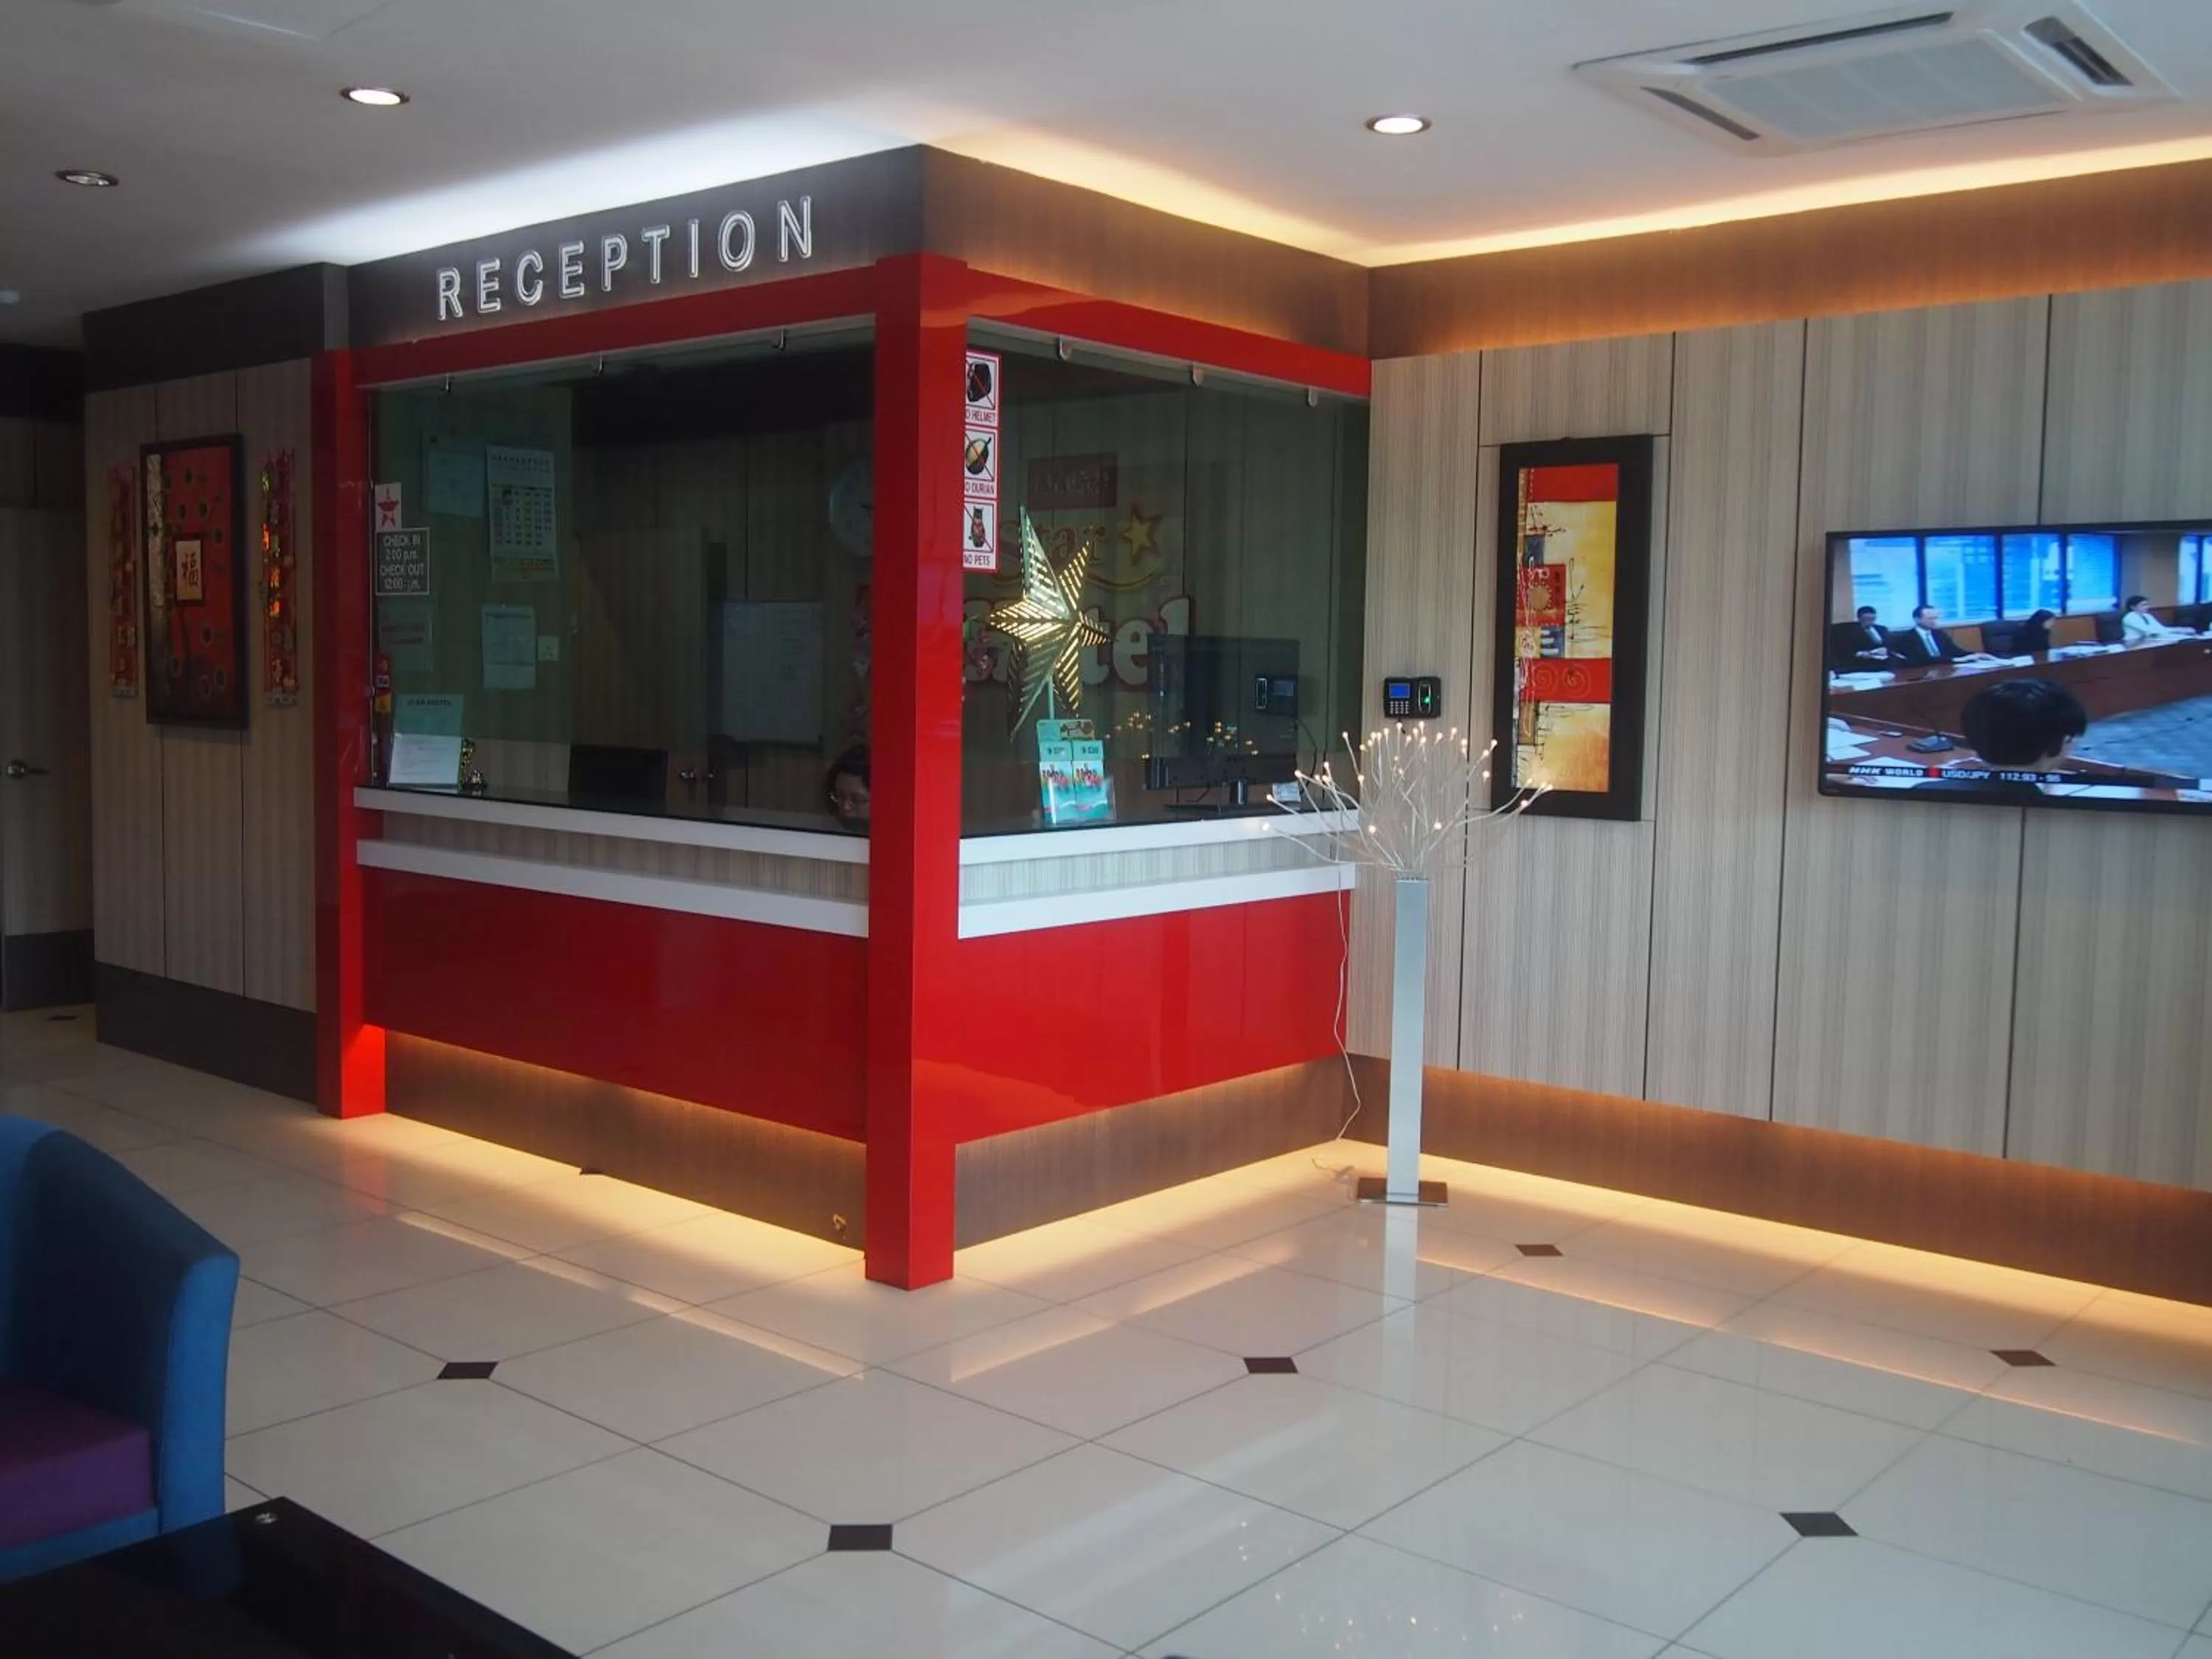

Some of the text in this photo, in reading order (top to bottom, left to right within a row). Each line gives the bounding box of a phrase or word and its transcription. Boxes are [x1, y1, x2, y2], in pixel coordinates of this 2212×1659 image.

[437, 195, 812, 320] RECEPTION
[972, 410, 995, 423] HELMET
[972, 483, 995, 496] DURIAN
[974, 554, 991, 566] PETS
[408, 563, 425, 577] OUT
[1848, 766, 1882, 775] NHK
[1885, 767, 1924, 776] WORLD
